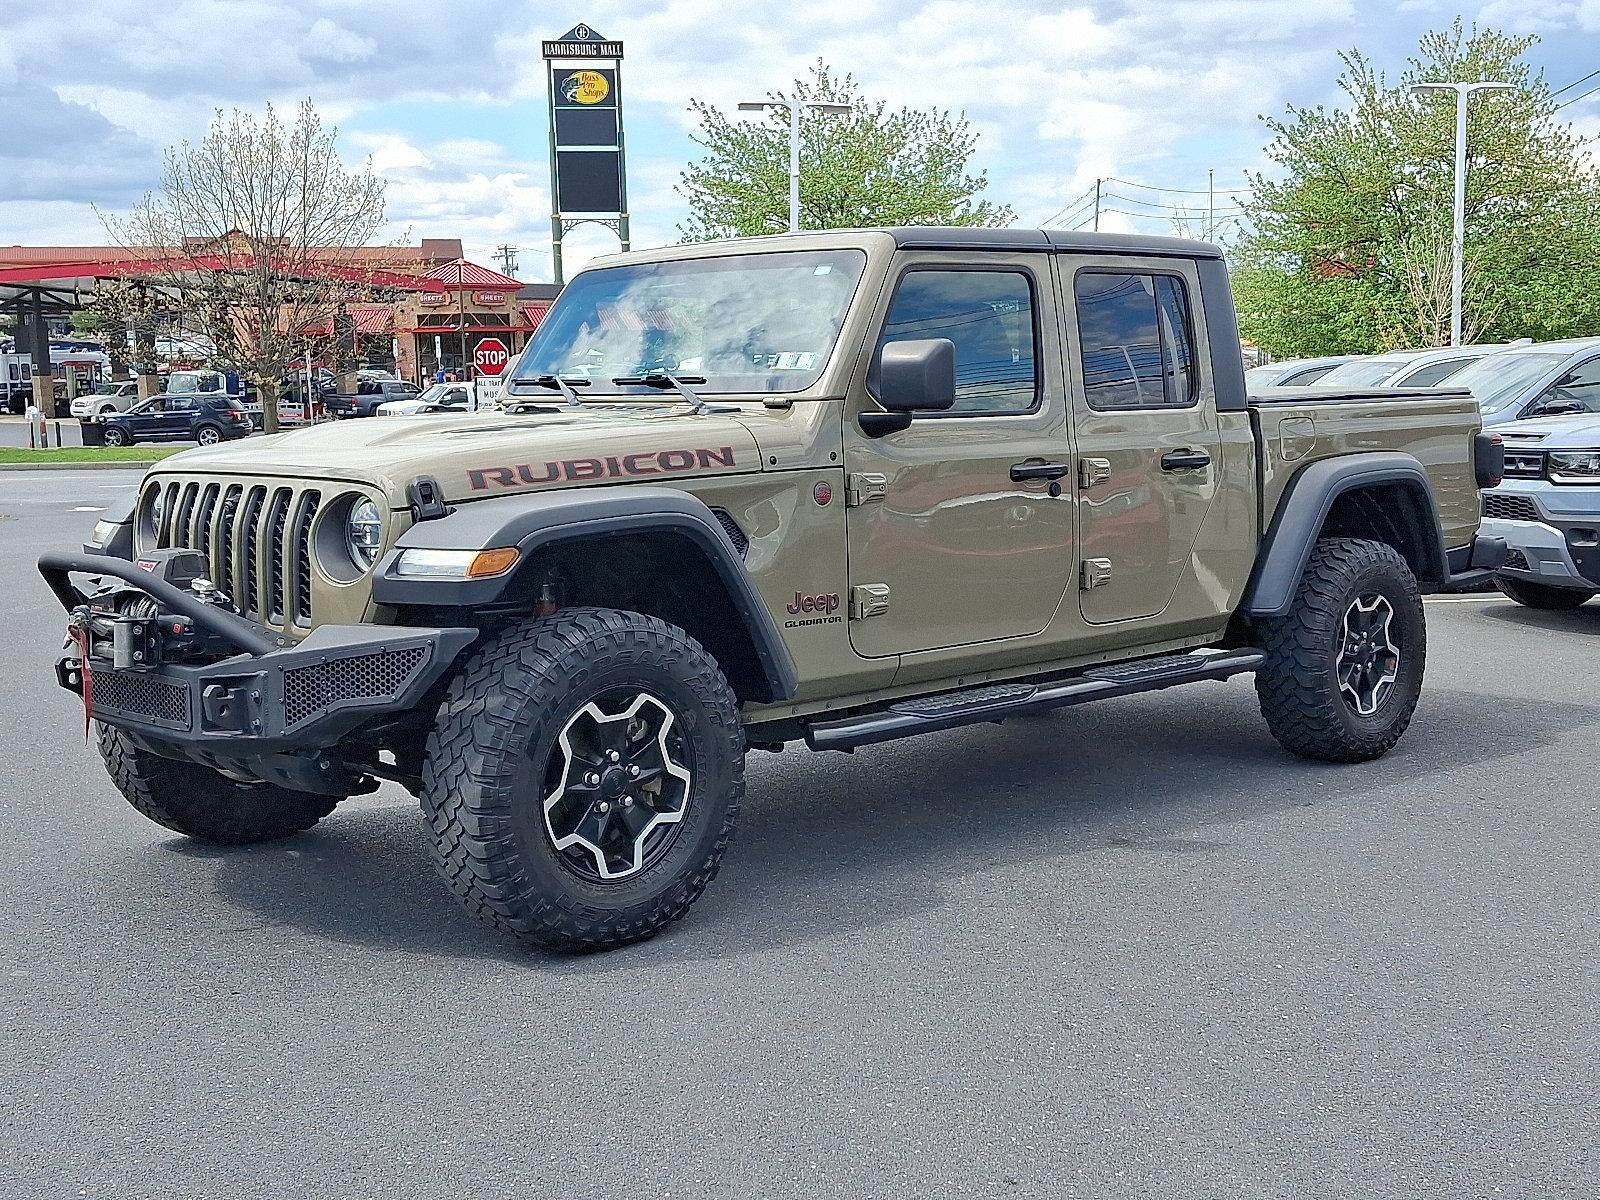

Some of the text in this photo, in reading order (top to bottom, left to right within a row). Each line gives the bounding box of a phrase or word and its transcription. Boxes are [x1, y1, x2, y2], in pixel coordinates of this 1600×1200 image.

[544, 43, 622, 55] HARRISBURG MALL
[582, 73, 599, 81] Bass
[581, 81, 596, 89] Pro
[583, 88, 604, 98] Shops
[476, 350, 506, 365] STOP
[484, 391, 499, 399] MUS
[467, 447, 736, 490] RUBICON
[785, 590, 840, 615] Jeep
[784, 616, 842, 629] GLADIATOR
